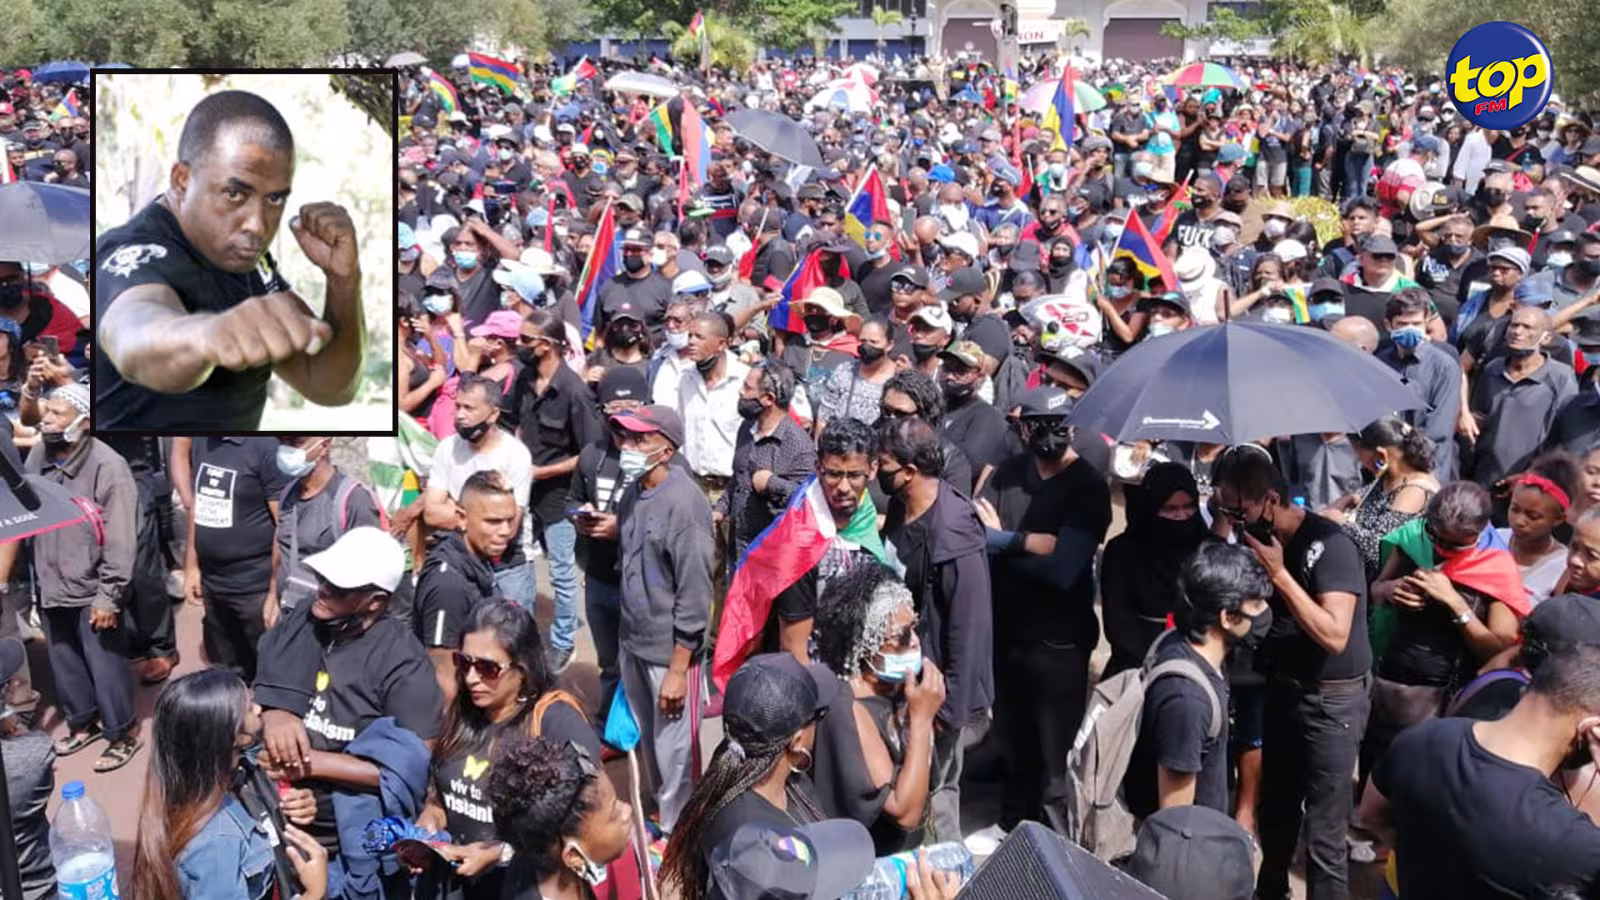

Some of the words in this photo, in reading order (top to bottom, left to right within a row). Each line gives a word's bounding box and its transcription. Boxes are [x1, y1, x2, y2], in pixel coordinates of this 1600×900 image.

[1178, 225, 1214, 248] FUCK
[450, 778, 468, 796] viv
[470, 784, 482, 801] to
